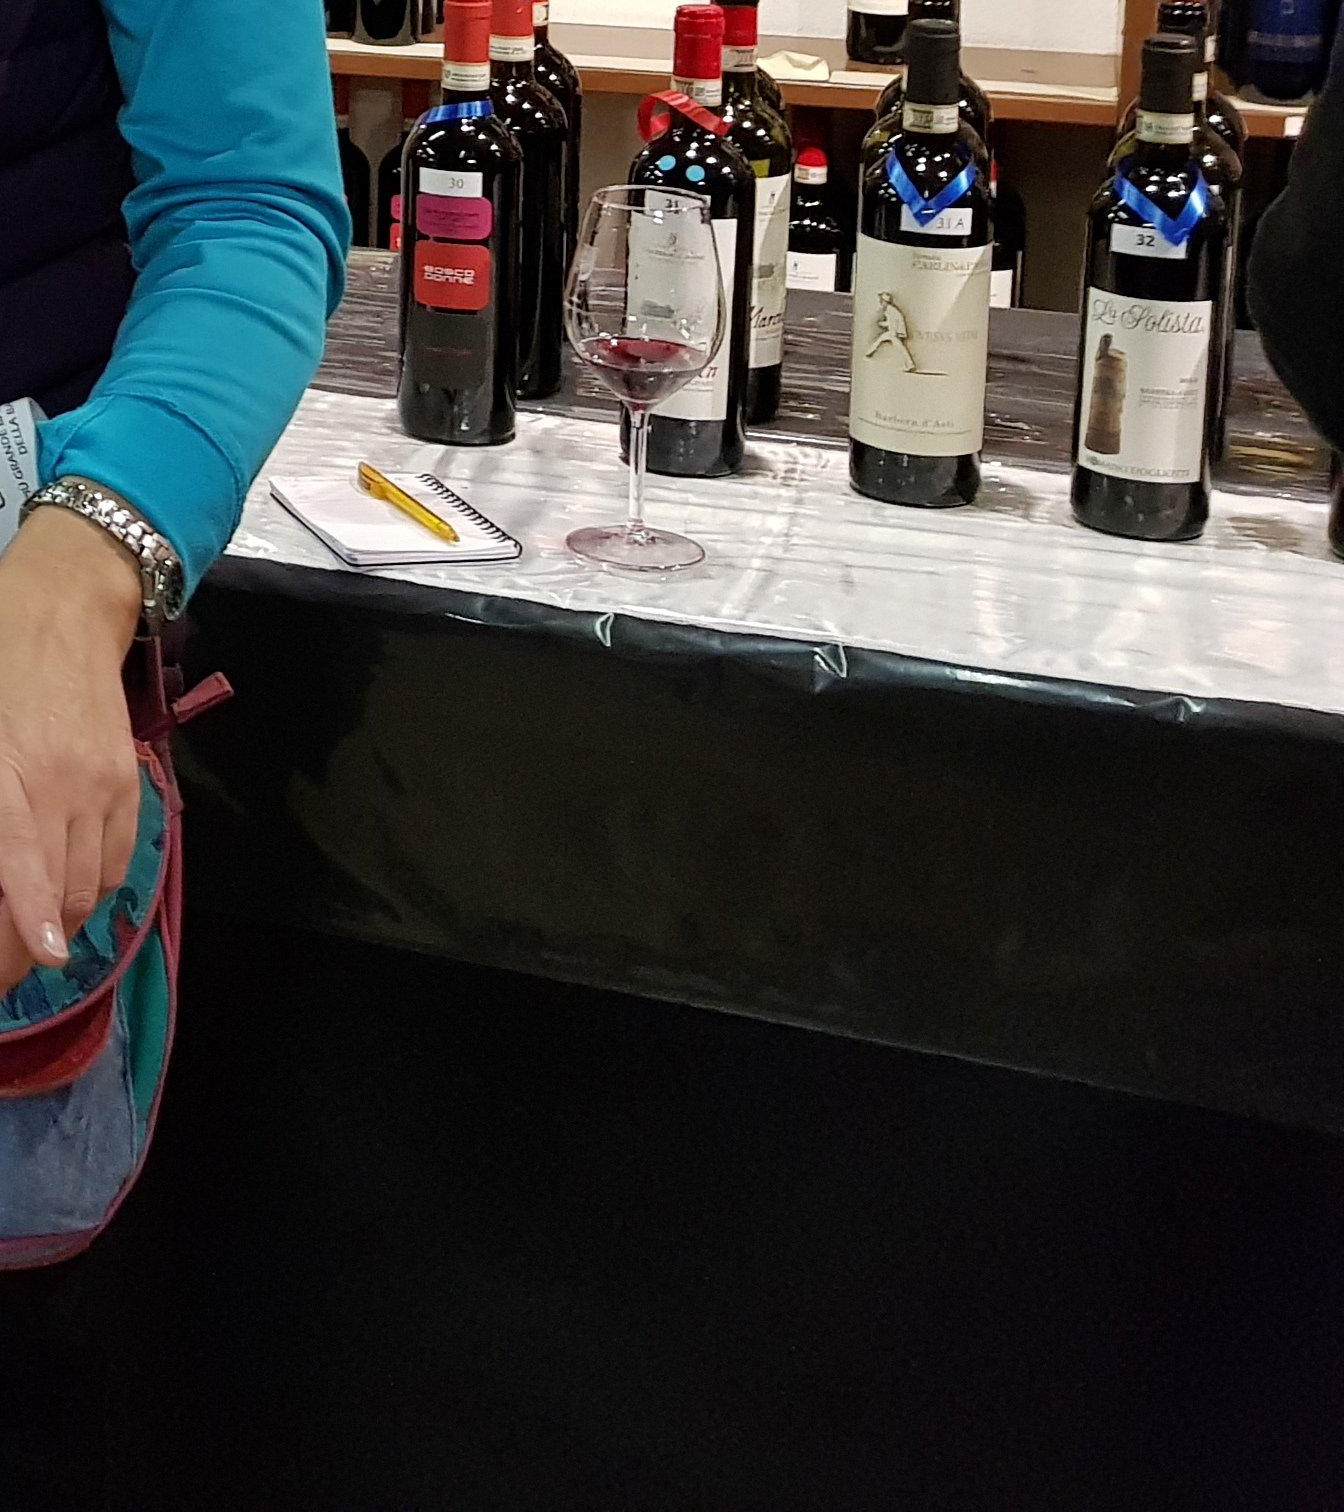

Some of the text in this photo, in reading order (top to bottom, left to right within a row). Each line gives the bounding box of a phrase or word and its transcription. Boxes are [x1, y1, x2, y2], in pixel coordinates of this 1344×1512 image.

[448, 177, 464, 190] 30
[1136, 234, 1155, 247] 32
[424, 272, 475, 285] DONNE
[10, 416, 29, 455] DELLA
